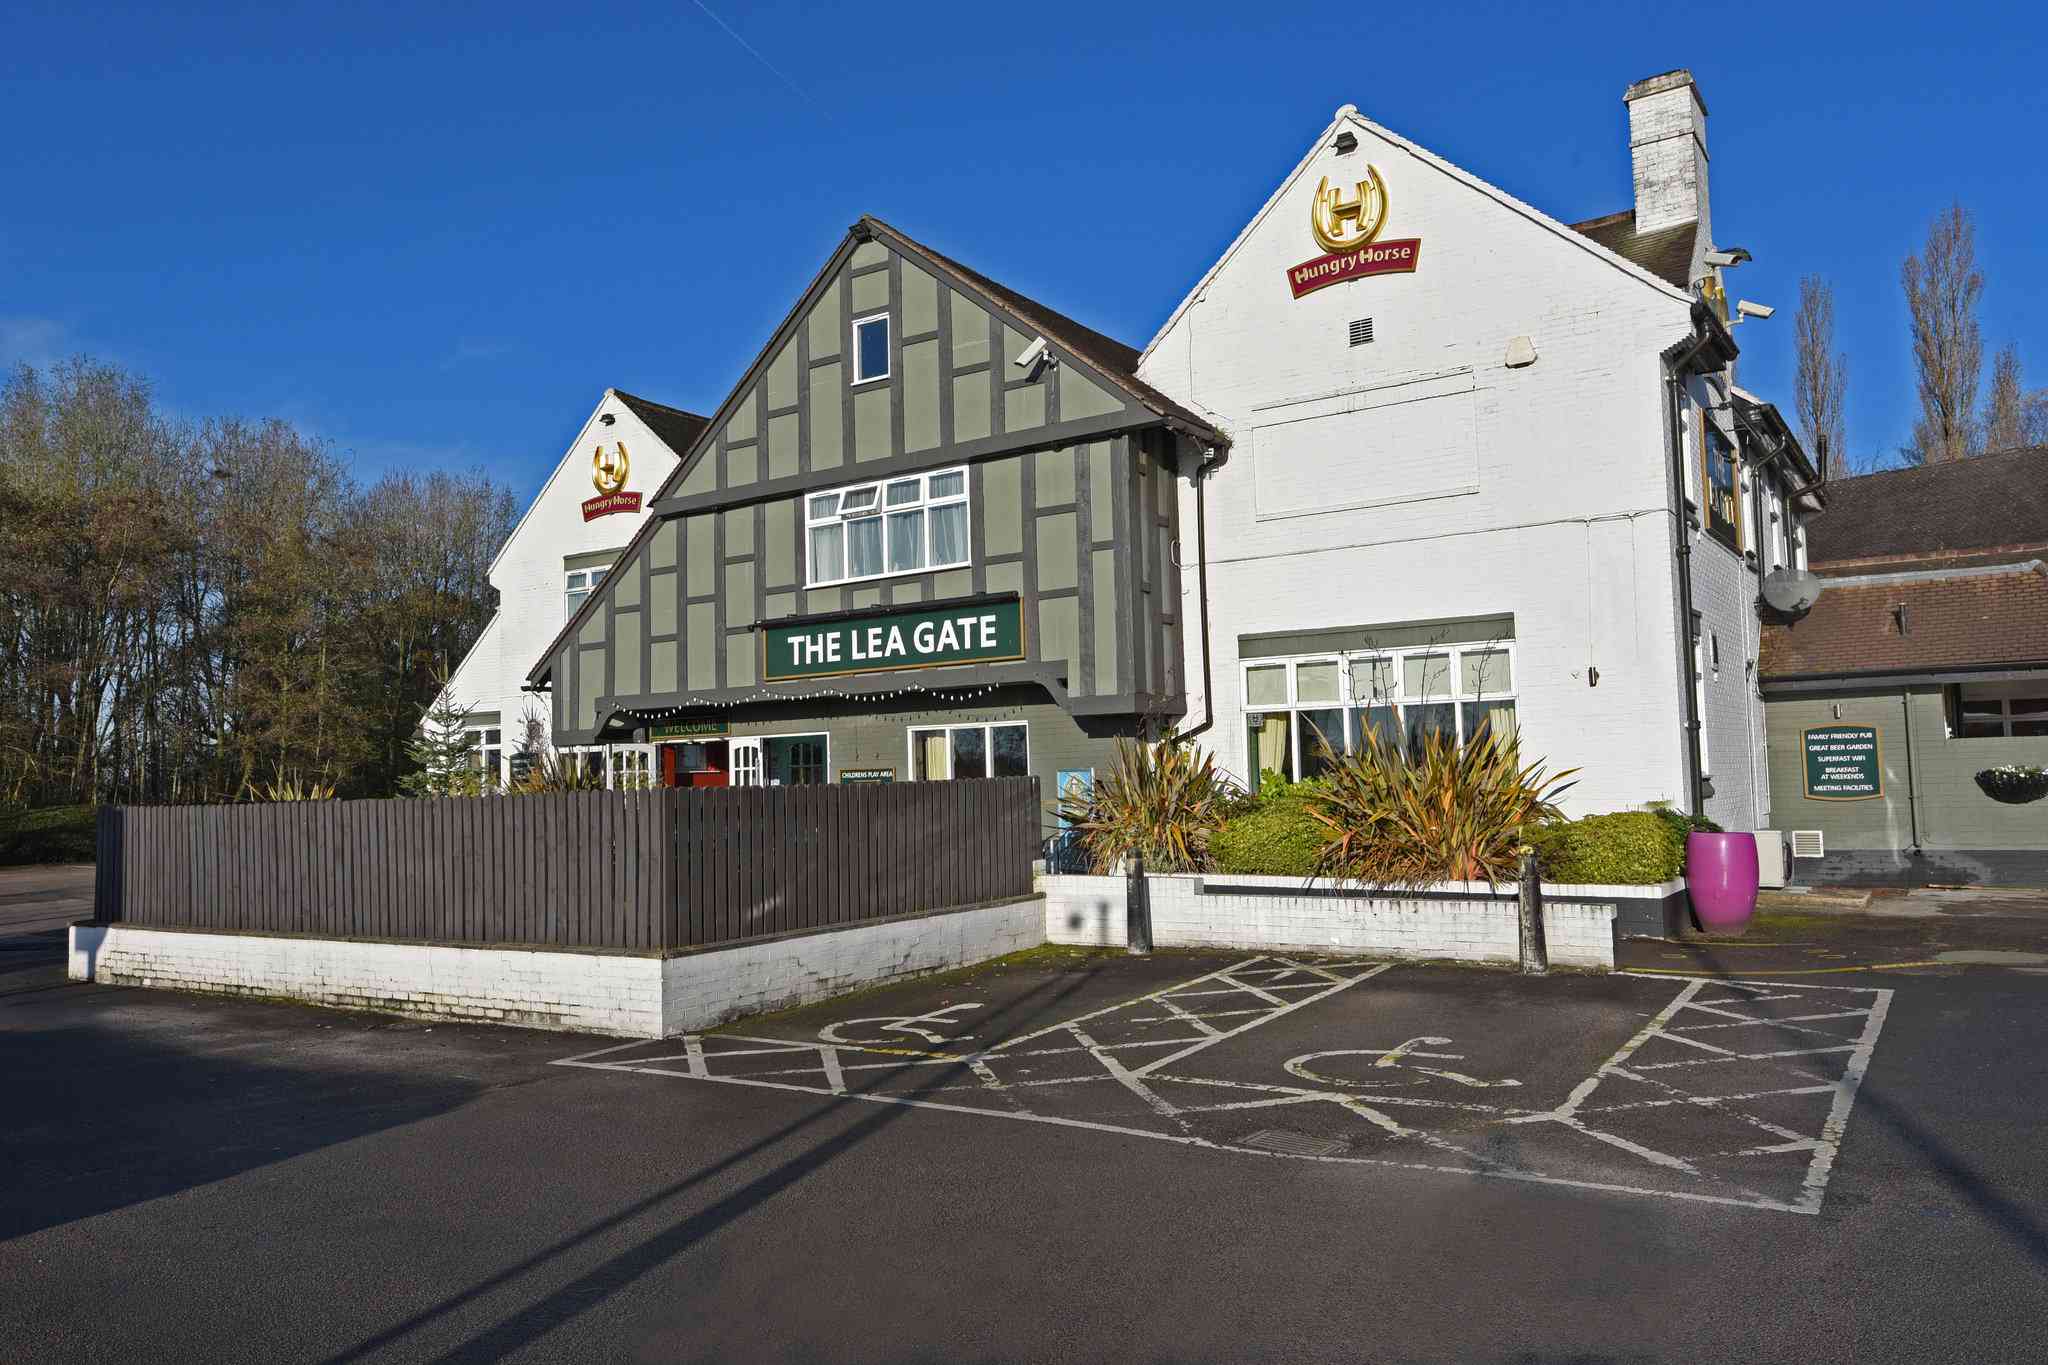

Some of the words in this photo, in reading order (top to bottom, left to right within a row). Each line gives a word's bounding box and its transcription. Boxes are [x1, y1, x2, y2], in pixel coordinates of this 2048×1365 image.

[1295, 255, 1357, 284] Hungry
[1359, 247, 1411, 264] Horse
[584, 498, 612, 513] Hungry
[613, 495, 637, 505] Horse
[787, 631, 841, 666] THE
[851, 625, 906, 660] LEA
[913, 614, 997, 654] GATE
